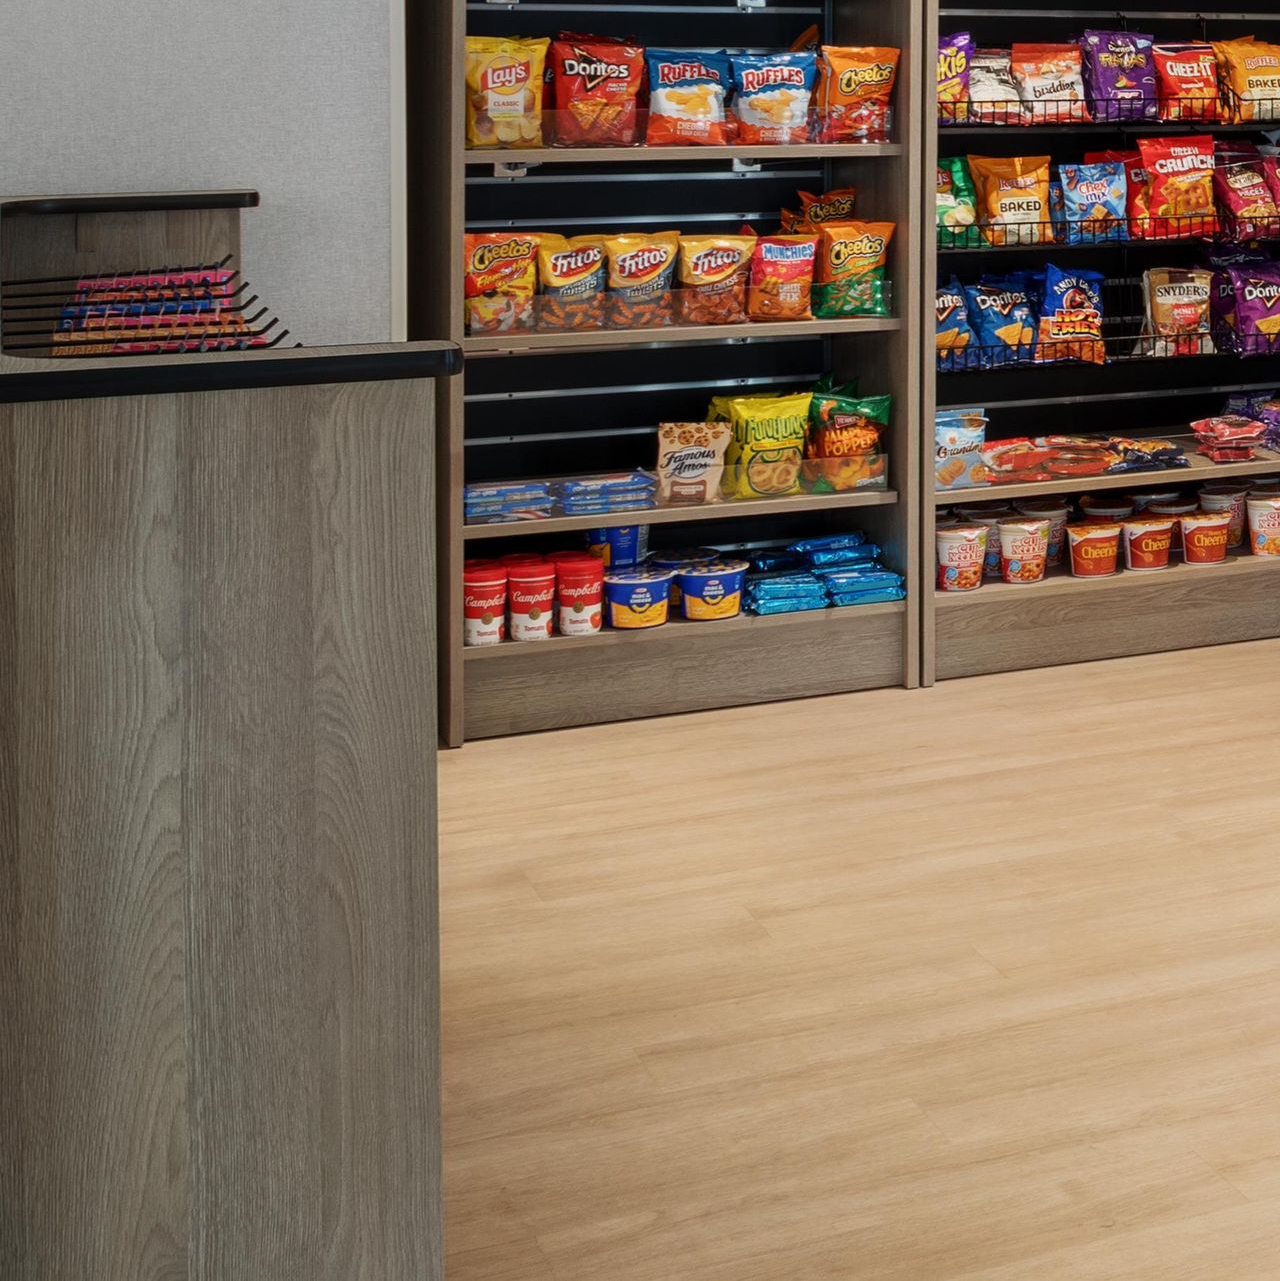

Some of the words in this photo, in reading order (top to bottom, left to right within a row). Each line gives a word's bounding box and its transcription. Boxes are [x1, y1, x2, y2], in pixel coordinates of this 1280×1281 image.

[565, 60, 630, 78] Doritos
[1166, 61, 1212, 77] CHEEZ-IT
[1245, 56, 1280, 70] RUFFLES
[487, 64, 526, 88] Lay's
[661, 63, 720, 83] RUFFLES
[743, 67, 804, 91] RUFFLES
[840, 64, 894, 94] Cheetos
[1033, 80, 1075, 99] buddies
[1155, 155, 1215, 173] CRUNCH
[1078, 182, 1108, 194] Chex
[1000, 201, 1041, 212] BAKED
[1086, 193, 1108, 203] mix
[810, 200, 854, 220] Cheetos
[474, 240, 532, 270] Cheetos
[831, 237, 885, 265] Cheetos
[551, 247, 601, 277] Fritos
[618, 248, 669, 278] Fritos
[692, 249, 742, 274] Fritos
[1054, 276, 1078, 295] ANDY
[1157, 286, 1209, 298] SNYDER'S
[976, 292, 1027, 310] Doritos
[1055, 309, 1099, 322] HOT
[1052, 321, 1101, 335] FRIES
[746, 416, 808, 442] FUNYUNS
[660, 447, 716, 469] Famous
[666, 461, 709, 479] Amos
